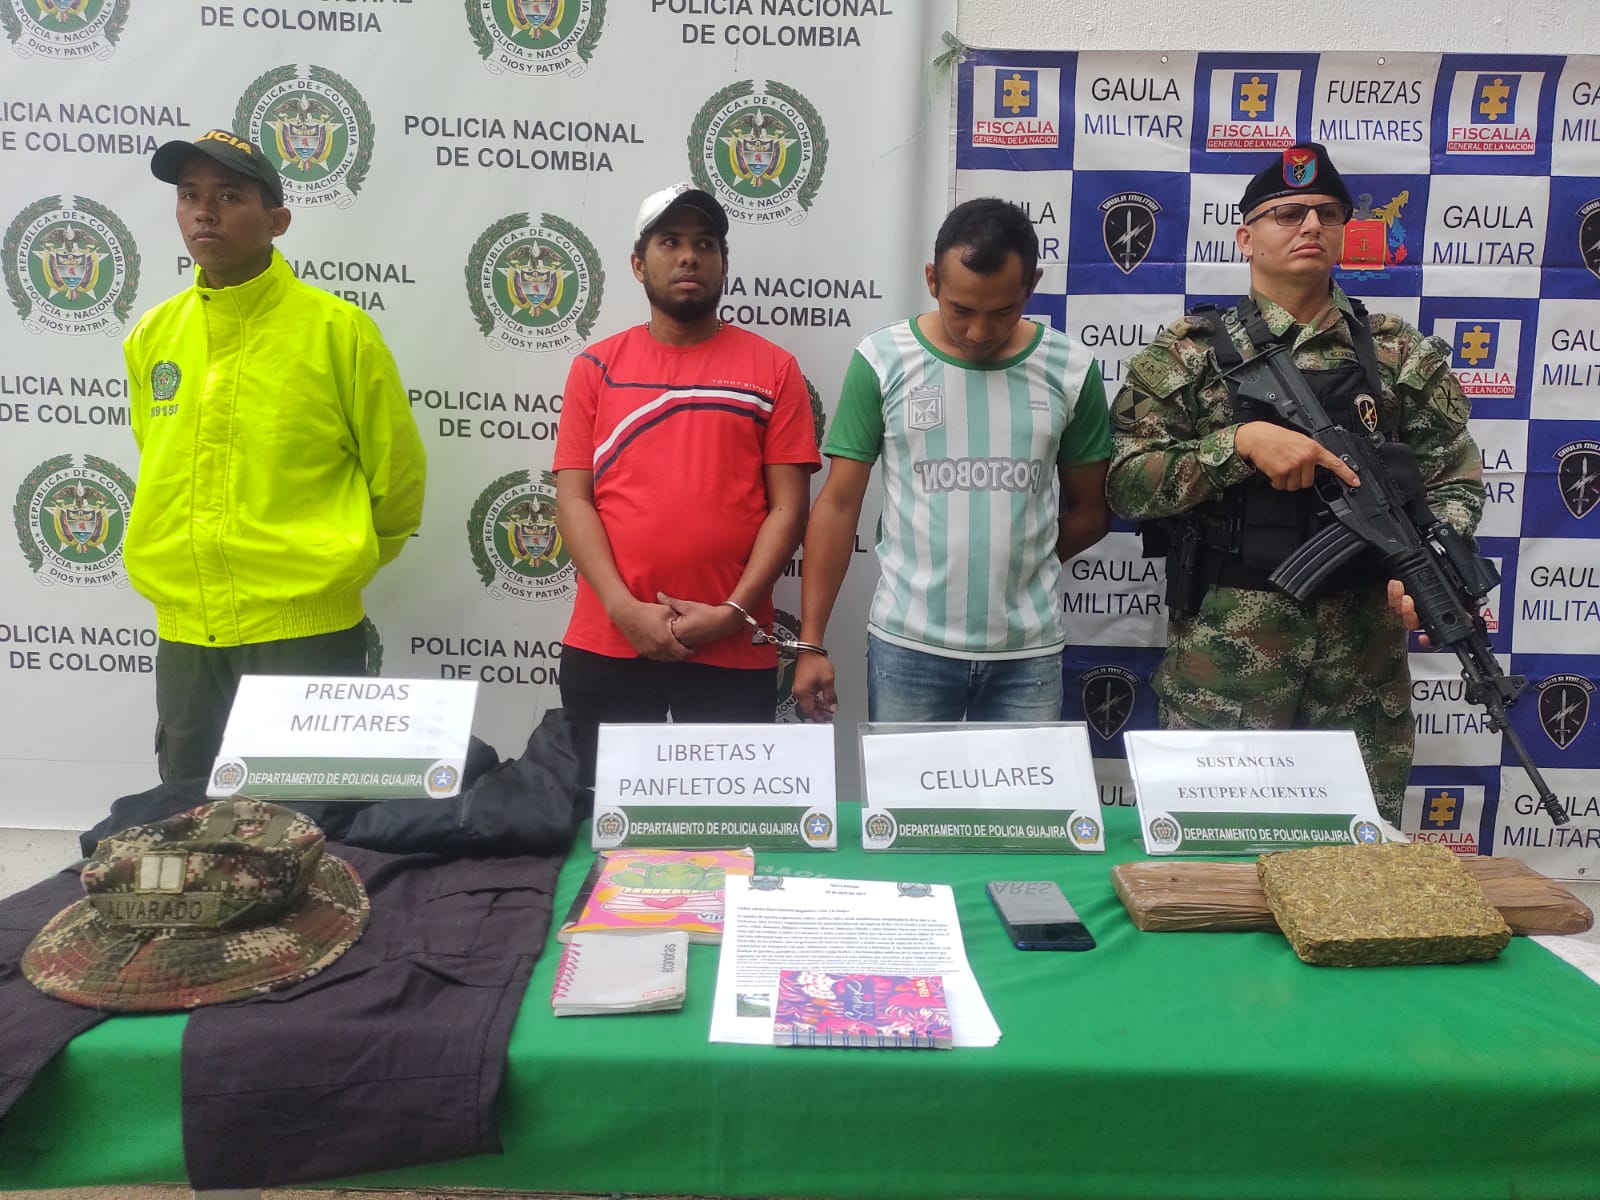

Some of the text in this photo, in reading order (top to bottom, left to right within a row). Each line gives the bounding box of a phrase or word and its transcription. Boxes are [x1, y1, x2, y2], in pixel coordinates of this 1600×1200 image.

[201, 6, 382, 33] DE COLOMBIA
[651, 0, 893, 17] POLICIA NACIONAL
[17, 8, 112, 42] POLICIA NACIONAL
[682, 24, 861, 47] DE COLOMBIA
[28, 38, 53, 55] DIOS
[64, 40, 100, 57] PATRIA
[489, 23, 584, 59] POLICIA NACIONAL
[500, 54, 526, 72] DIOS
[536, 57, 572, 73] PATRIA
[1091, 77, 1180, 101] GAULA
[1327, 80, 1422, 104] FUERZAS
[0, 102, 191, 127] ICIA NACIONAL
[251, 81, 358, 146] REPUBLICA DE COLOMBIA
[404, 115, 645, 144] POLICIA NACIONAL
[705, 96, 811, 162] REPUBLICA DE COLOMBIA
[976, 121, 1054, 134] FISCALIA
[1084, 113, 1183, 138] MILITAR
[1211, 125, 1292, 138] FISCALIA
[1319, 119, 1423, 141] MILITARES
[1452, 127, 1531, 141] FISCALIA
[1, 131, 159, 155] E COLOMBIA
[974, 135, 1057, 145] GENERAL DE LA NACION
[1207, 139, 1296, 149] GENERAL DE LA NACION
[1448, 142, 1534, 151] GENERAL DE LA NACION
[436, 146, 613, 172] DE COLOMBIA
[305, 157, 353, 191] NACIONAL
[305, 188, 341, 205] PATRIA
[711, 172, 806, 208] POLICIA NACIONAL
[721, 203, 747, 220] DIOS
[756, 205, 793, 222] PATRIA
[1443, 205, 1534, 229] GAULA
[19, 211, 124, 275] REPUBLICA DE COLOMBIA
[1433, 242, 1535, 265] MILITAR
[483, 228, 587, 293] REPUBLICA DE COLOMBIA
[754, 278, 883, 299] NACIONAL
[26, 285, 119, 320] POLICIA NACIONAL
[38, 315, 63, 331] DIOS
[74, 317, 110, 333] PATRIA
[489, 302, 584, 336] POLICIA NACIONAL
[718, 305, 851, 327] COLOMBIA
[501, 332, 526, 348] DIOS
[536, 334, 572, 350] PATRIA
[71, 379, 129, 398] NACI
[1464, 386, 1514, 395] DE LA NACION
[407, 389, 507, 412] POLICIA
[37, 404, 131, 425] COLOM
[439, 418, 471, 438] DE
[31, 470, 88, 527] REPUBLICA DE
[484, 485, 544, 541] REPUBLICA DE
[37, 539, 72, 571] POLICIA
[50, 567, 75, 583] DIOS
[84, 570, 118, 585] PATRIA
[490, 552, 524, 585] POLICIA
[1071, 559, 1158, 582] GAULA
[1531, 566, 1600, 588] GAUL
[502, 582, 525, 598] DIOS
[535, 584, 570, 599] PATRIA
[1063, 592, 1161, 615] MILITAR
[1522, 600, 1600, 622] MILITA
[81, 627, 157, 647] NACIO
[411, 637, 506, 658] POLICIA
[9, 651, 154, 673] DE COLOMB
[304, 683, 410, 701] PRENDAS
[290, 714, 410, 732] MILITARES
[657, 743, 775, 761] LIBRETAS Y
[1197, 756, 1295, 768] SUSTANCIAS
[249, 773, 422, 786] DEPARTAMENTO DE POLICIA GUAJIRA
[619, 776, 810, 796] PANFLETOS ACSN
[920, 766, 1054, 790] CELULARES
[1178, 787, 1328, 799] ESTUPEFACIENTES
[631, 822, 798, 835] DEPARTAMENTO DE POLICIA GUAJIRA
[900, 824, 1067, 838] DEPARTAMENTO DE POLICIA GUAJIRA
[1184, 828, 1350, 841] DEPARTAMENTO DE POLICIA GUAJIRA
[1504, 826, 1600, 849] MILITAR
[110, 900, 202, 921] ALVARADO
